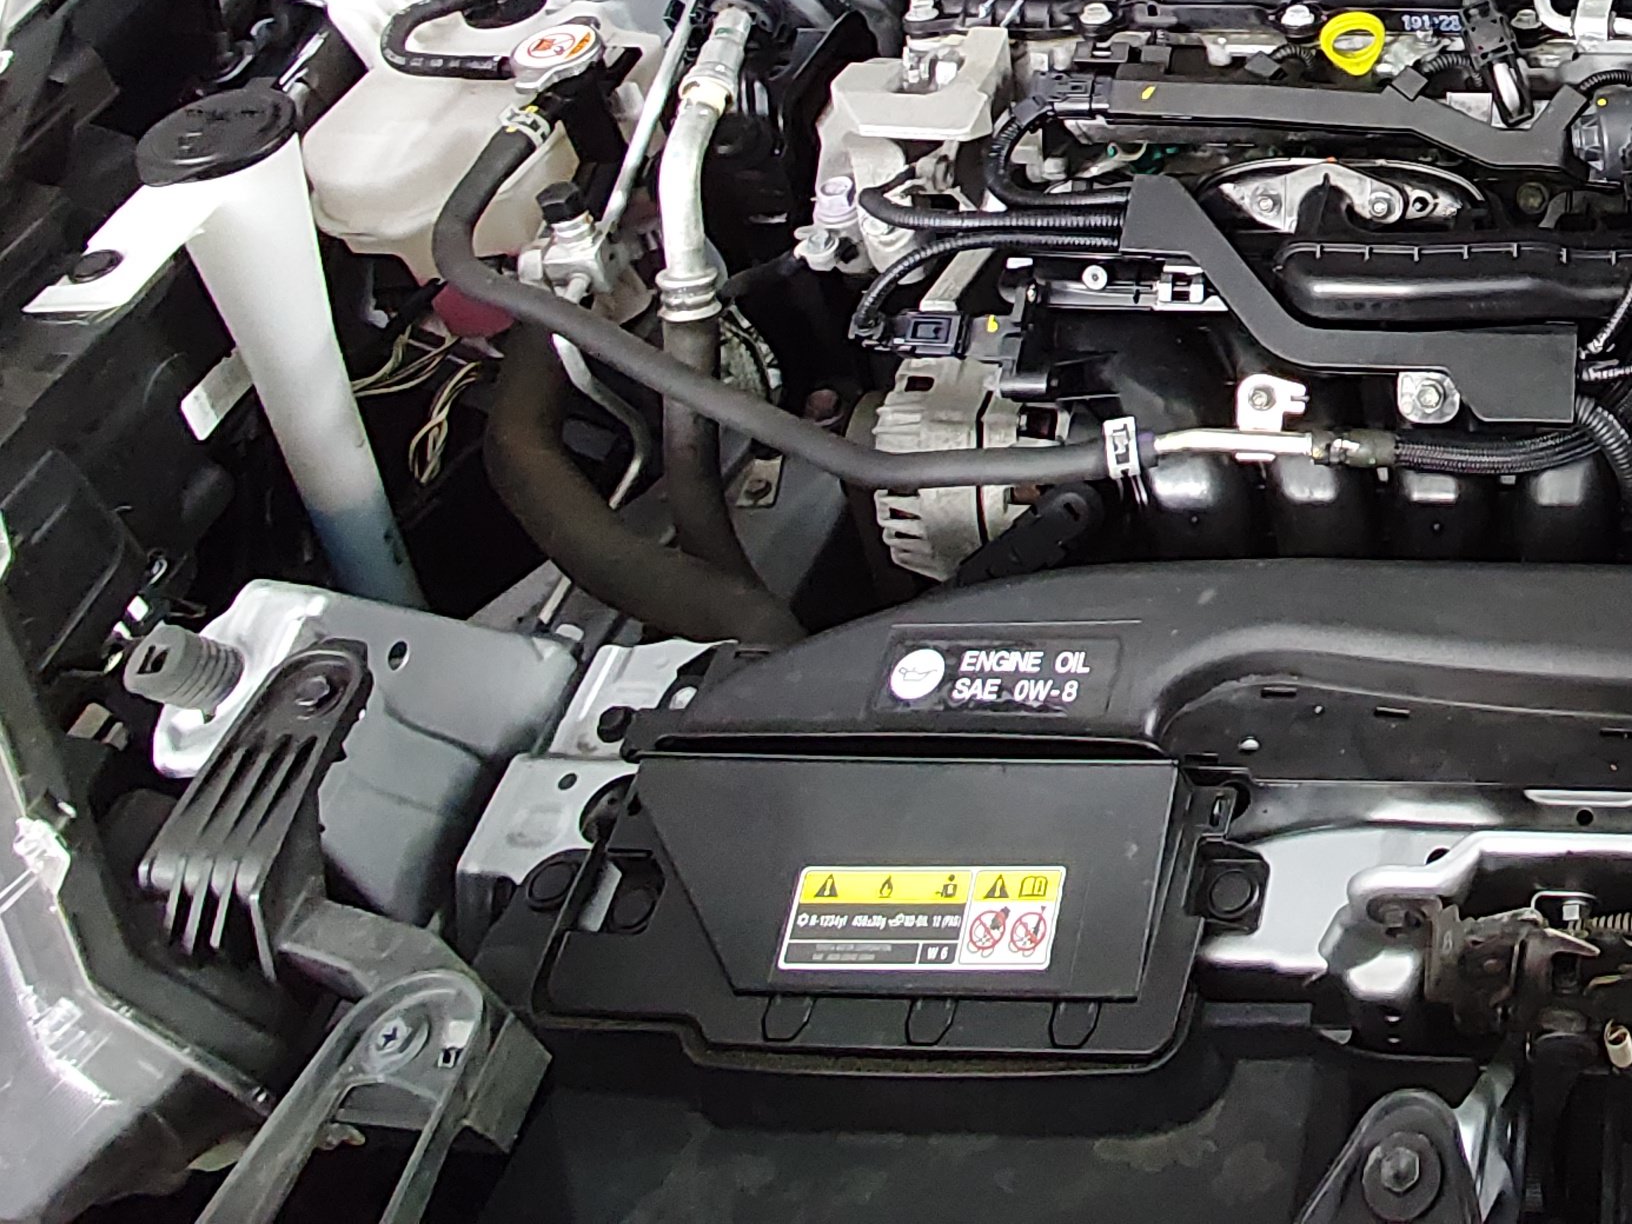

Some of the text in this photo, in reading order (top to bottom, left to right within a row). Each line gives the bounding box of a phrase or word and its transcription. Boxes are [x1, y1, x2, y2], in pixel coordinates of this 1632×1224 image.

[960, 650, 1090, 673] ENGINE OIL
[951, 677, 1079, 702] SAE 0W-8
